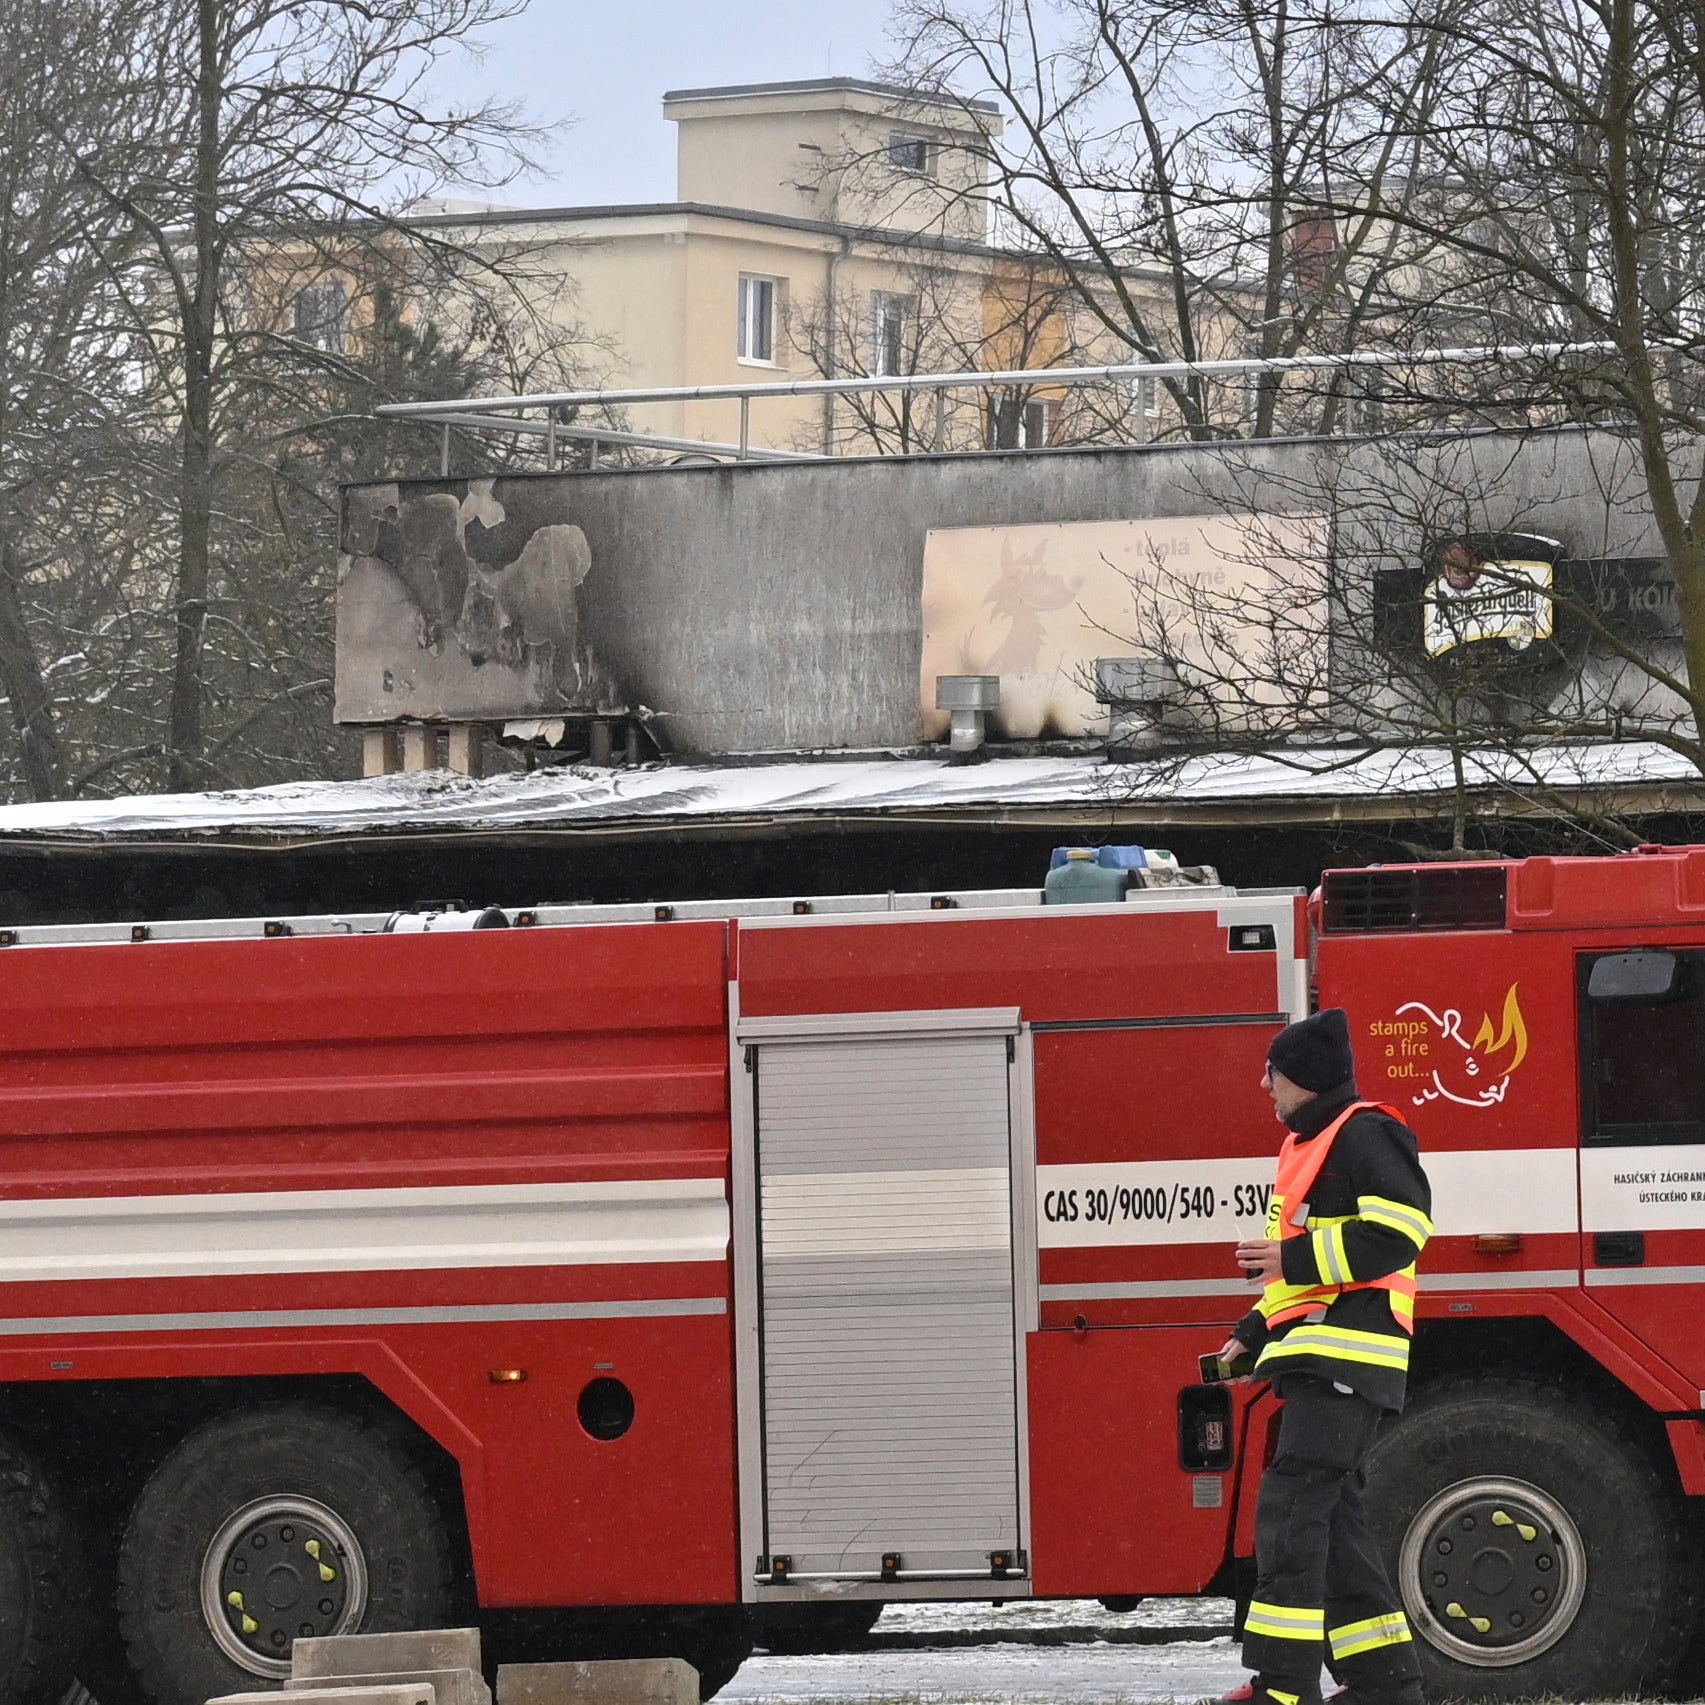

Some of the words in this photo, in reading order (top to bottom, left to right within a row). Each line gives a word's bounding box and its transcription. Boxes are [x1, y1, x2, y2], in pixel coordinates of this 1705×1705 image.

[1370, 1020, 1429, 1039] stamps
[1385, 1043, 1394, 1056] a
[1401, 1038, 1429, 1056] fire
[1387, 1062, 1430, 1078] out...
[1613, 1170, 1656, 1184] HASIČSKÝ
[1044, 1190, 1079, 1223] CAS
[1085, 1183, 1215, 1225] 30/9000/540
[1234, 1184, 1275, 1217] S3V
[1639, 1190, 1687, 1203] ÚSTECKÉHO
